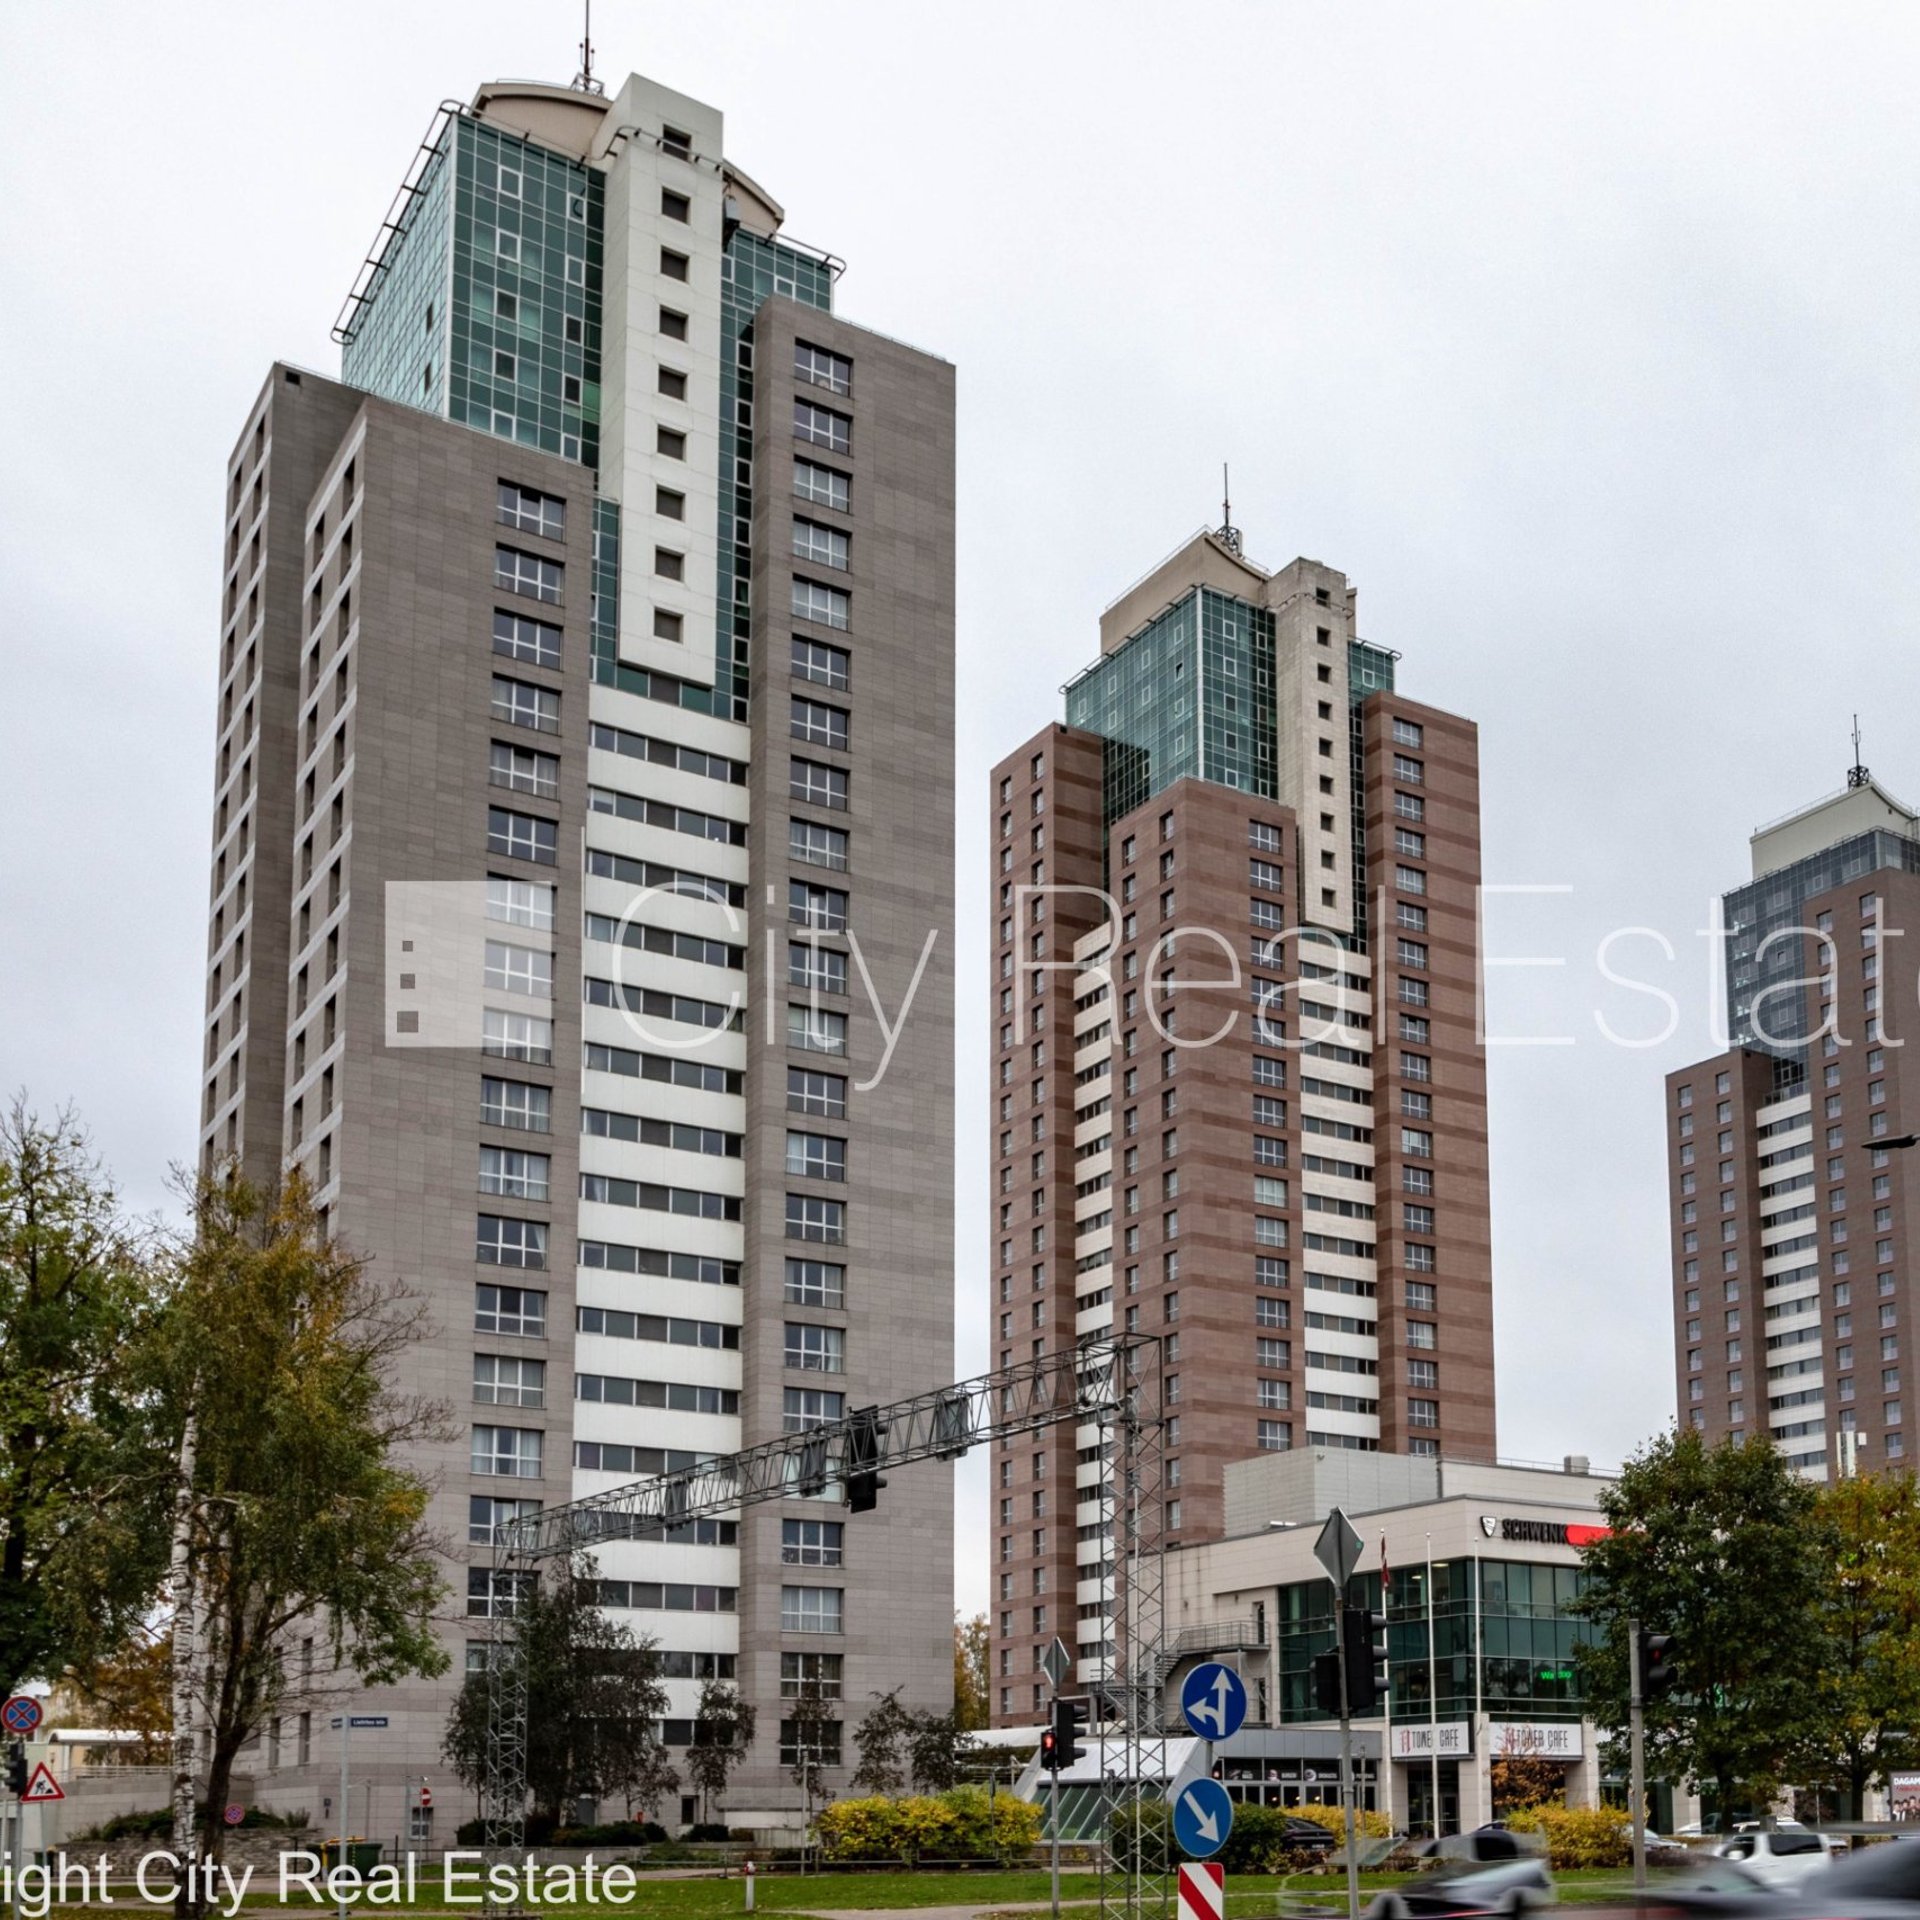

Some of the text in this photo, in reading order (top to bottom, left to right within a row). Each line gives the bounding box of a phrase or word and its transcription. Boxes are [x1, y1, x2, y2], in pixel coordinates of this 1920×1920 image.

[1502, 1518, 1567, 1544] SCHWENK
[1412, 1728, 1459, 1748] TOWE CAFE
[1547, 1729, 1568, 1748] CAFE
